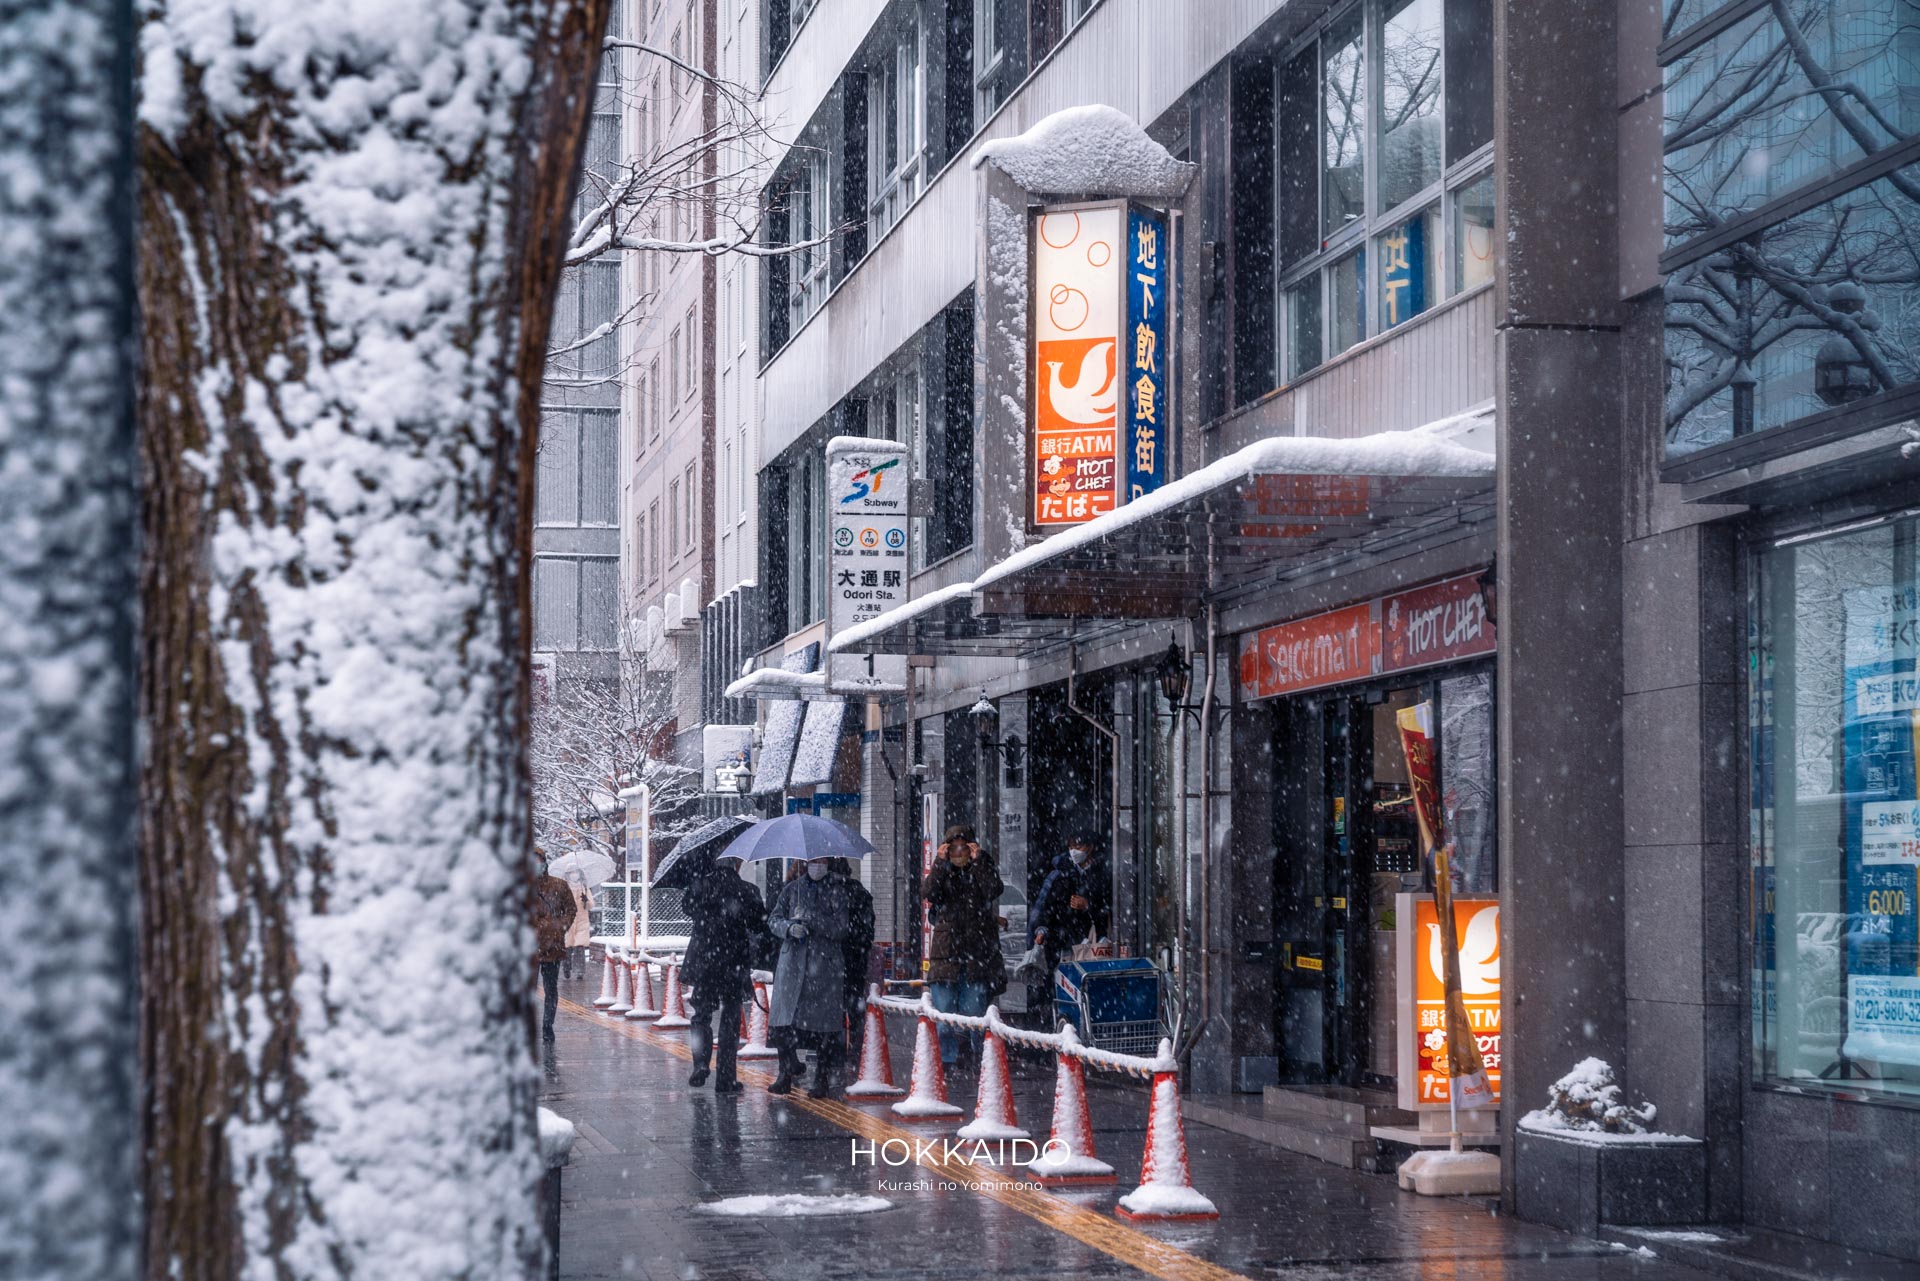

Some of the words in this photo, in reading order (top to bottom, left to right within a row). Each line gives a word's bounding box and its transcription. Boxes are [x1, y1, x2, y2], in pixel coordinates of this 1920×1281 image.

[1136, 221, 1157, 474] 地下飲食街
[1041, 434, 1113, 455] 銀行ATM
[1077, 459, 1114, 475] HOT
[1075, 475, 1112, 491] CHEF
[864, 498, 898, 509] Subway
[1041, 494, 1111, 520] たばこ
[838, 569, 902, 587] 大通駅
[843, 590, 873, 599] Odori
[875, 590, 896, 599] Sta.
[1408, 604, 1443, 655] HOT
[1442, 592, 1487, 647] CHEF
[863, 653, 874, 677] 1
